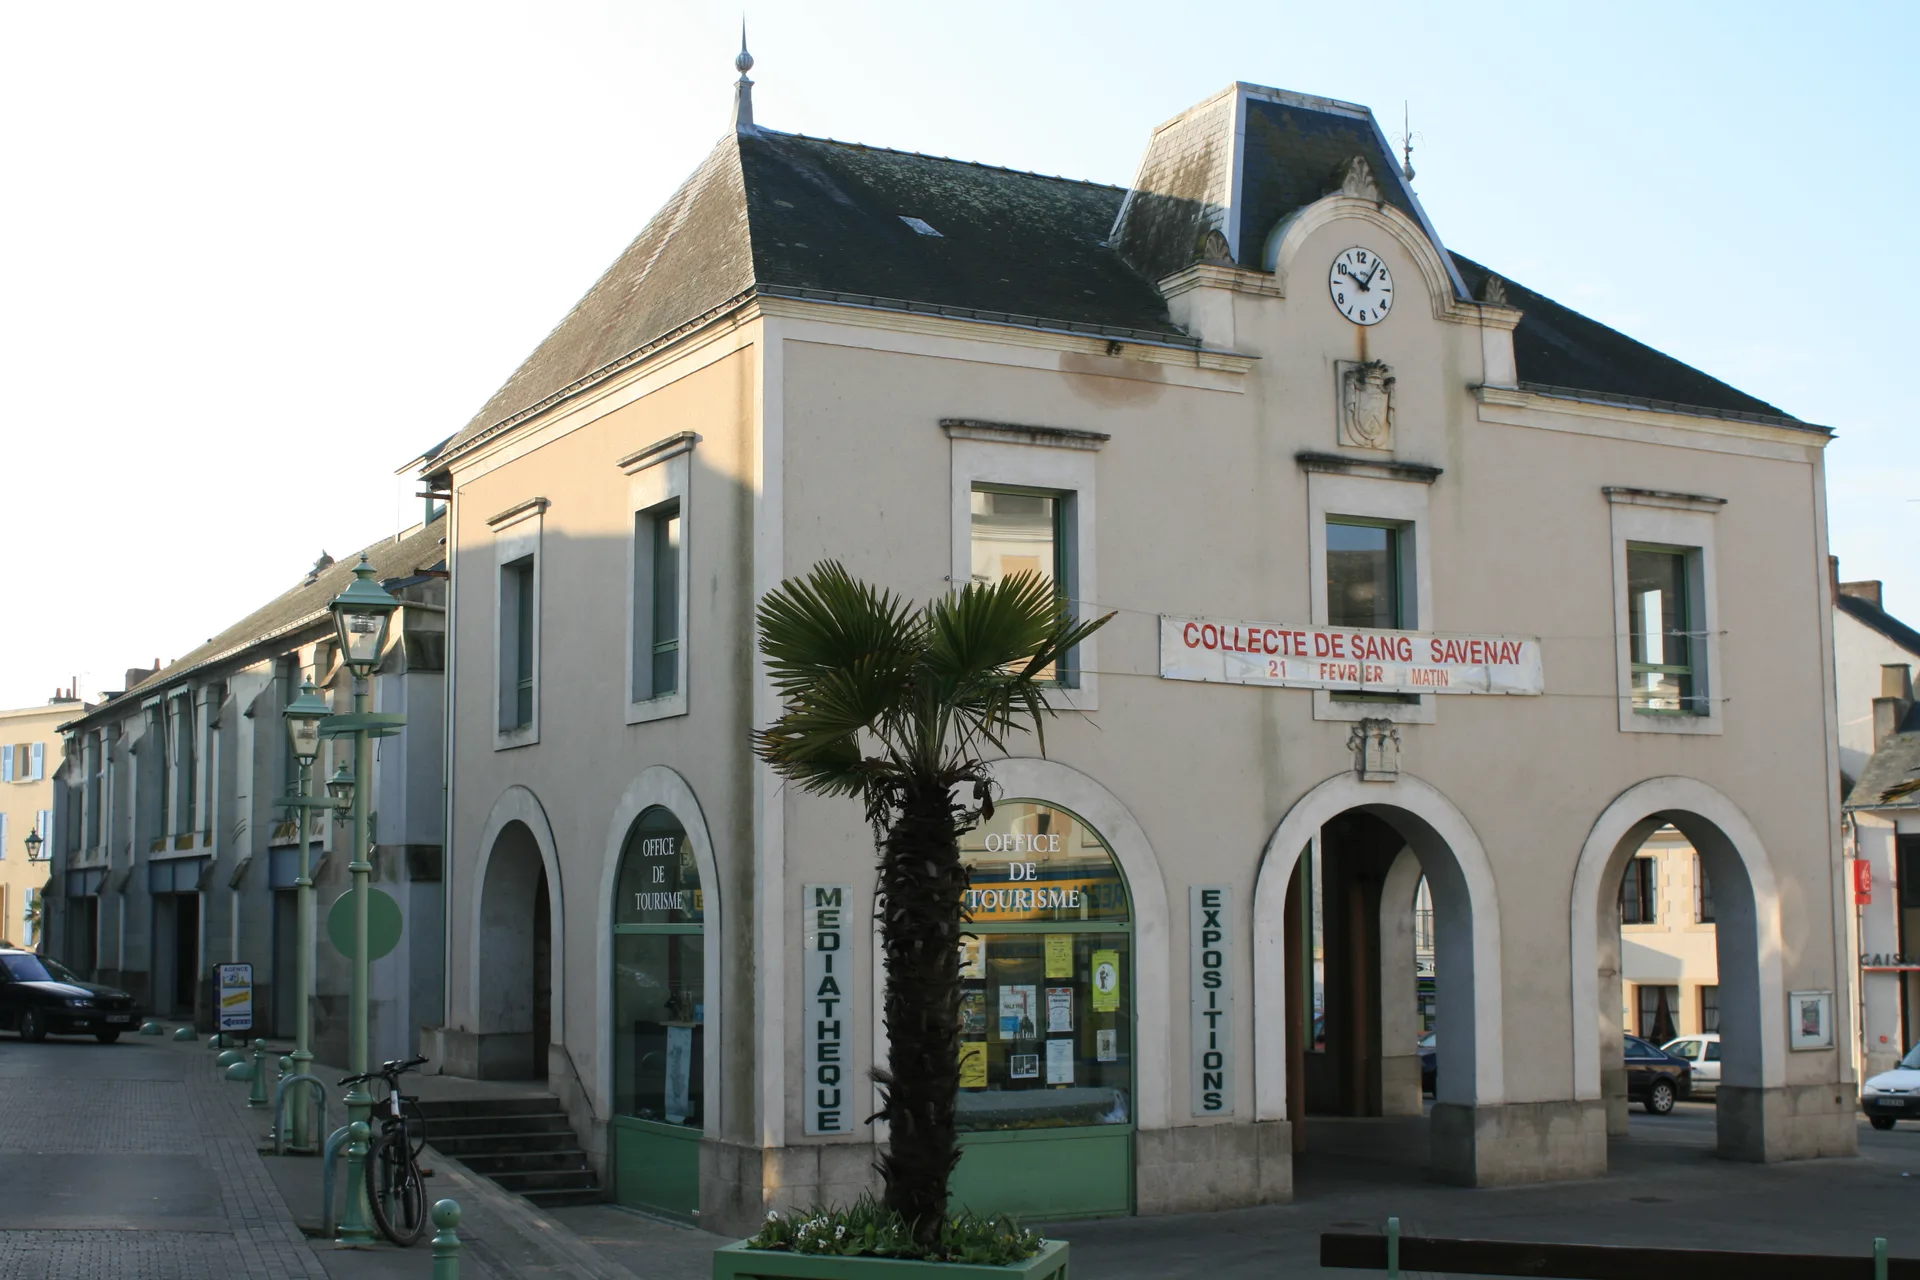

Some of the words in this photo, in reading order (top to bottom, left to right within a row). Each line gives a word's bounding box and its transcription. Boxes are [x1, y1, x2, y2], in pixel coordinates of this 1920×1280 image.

[1356, 251, 1367, 264] 12
[1337, 262, 1347, 275] 10
[1379, 268, 1386, 280] 2
[1338, 292, 1345, 305] 8
[1379, 298, 1387, 311] 4
[1359, 309, 1366, 321] 6
[1183, 622, 1308, 657] COLLECTE
[1314, 632, 1345, 659] DE
[1351, 634, 1413, 662] SANG
[1430, 638, 1523, 665] SAVENAY
[1268, 660, 1287, 678] 21
[1412, 668, 1448, 687] MATIN
[642, 837, 675, 857] OFFICE
[984, 832, 1061, 853] OFFICE
[652, 865, 665, 883] DE
[1009, 862, 1038, 881] DE
[635, 891, 683, 911] TOURISME
[966, 889, 1080, 909] TOURISME
[815, 887, 842, 1132] MEDIATHEQUE
[1201, 889, 1223, 1112] EXPOSITIONS
